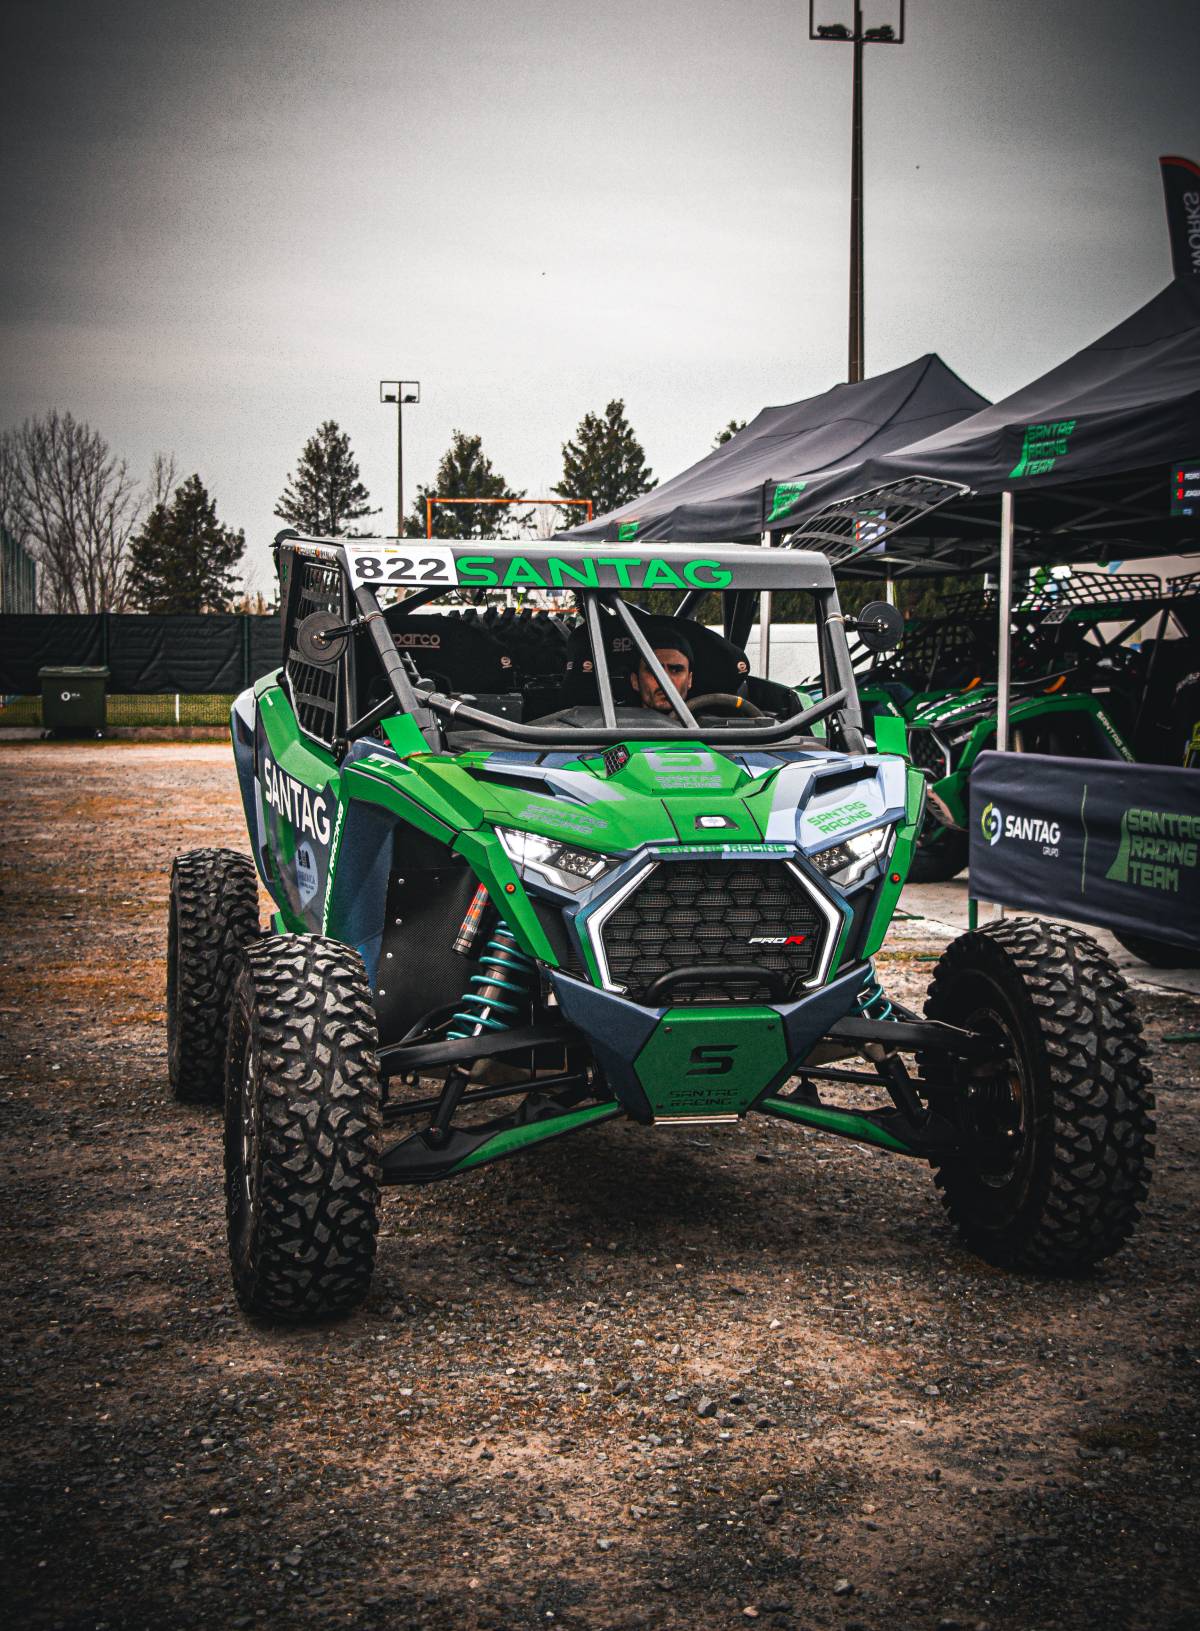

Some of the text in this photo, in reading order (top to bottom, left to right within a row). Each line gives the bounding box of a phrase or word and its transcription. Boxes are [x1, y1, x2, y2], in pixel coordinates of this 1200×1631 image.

[1025, 458, 1056, 476] TEAM
[354, 556, 450, 581] 822
[455, 556, 734, 589] SANTAG
[391, 633, 441, 647] parco
[264, 757, 330, 845] SANTAG
[807, 801, 867, 826] SANTAG
[818, 810, 873, 834] RACING
[1004, 815, 1061, 845] SANTAG
[1130, 834, 1198, 868] RACING
[1128, 860, 1179, 892] TEAM
[670, 1088, 739, 1097] SANTAG
